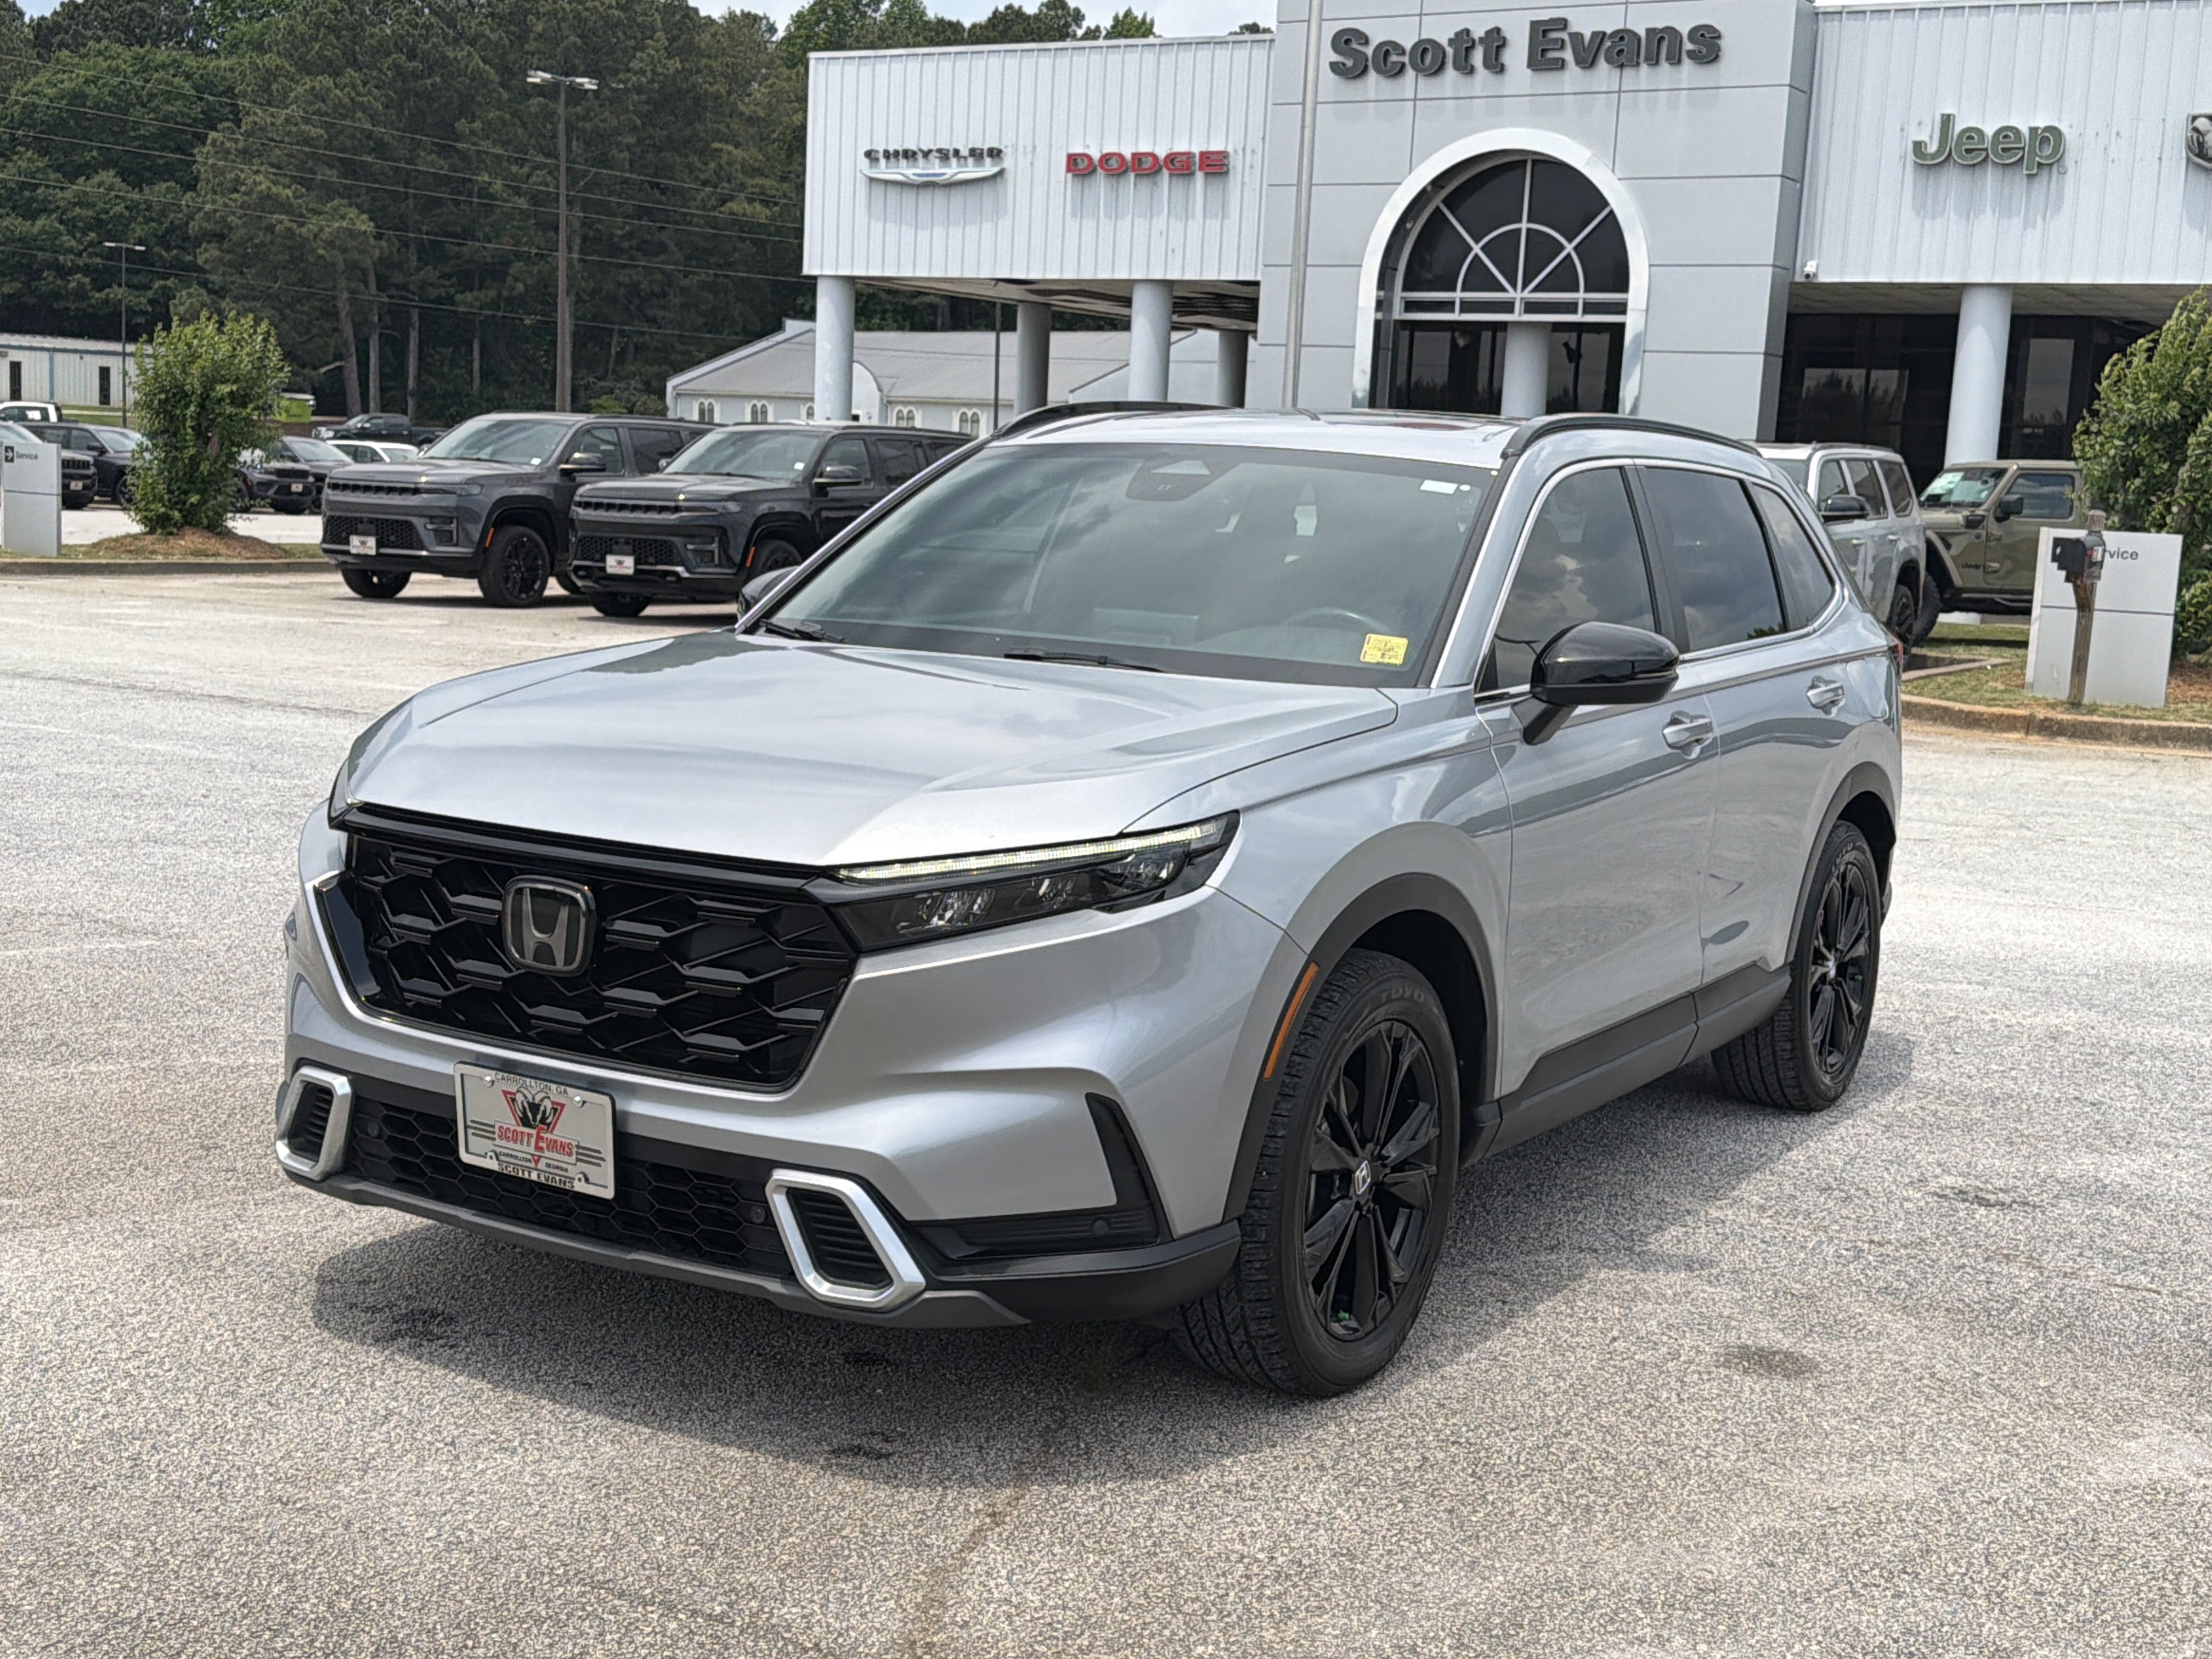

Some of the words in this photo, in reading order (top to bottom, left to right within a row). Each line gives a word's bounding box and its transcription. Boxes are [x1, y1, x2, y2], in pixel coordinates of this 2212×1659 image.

[1329, 26, 1506, 78] Scott
[1526, 16, 1722, 71] Evans
[864, 146, 1005, 161] CHRYSLER
[1912, 113, 2066, 174] Jeep
[1066, 150, 1230, 174] DODGE
[556, 1086, 569, 1096] GA
[498, 1125, 533, 1147] SCOTT
[534, 1124, 574, 1157] EVANS
[498, 1163, 532, 1178] SCOTT
[537, 1172, 575, 1189] EVANS
[545, 1162, 569, 1173] GEORGIA
